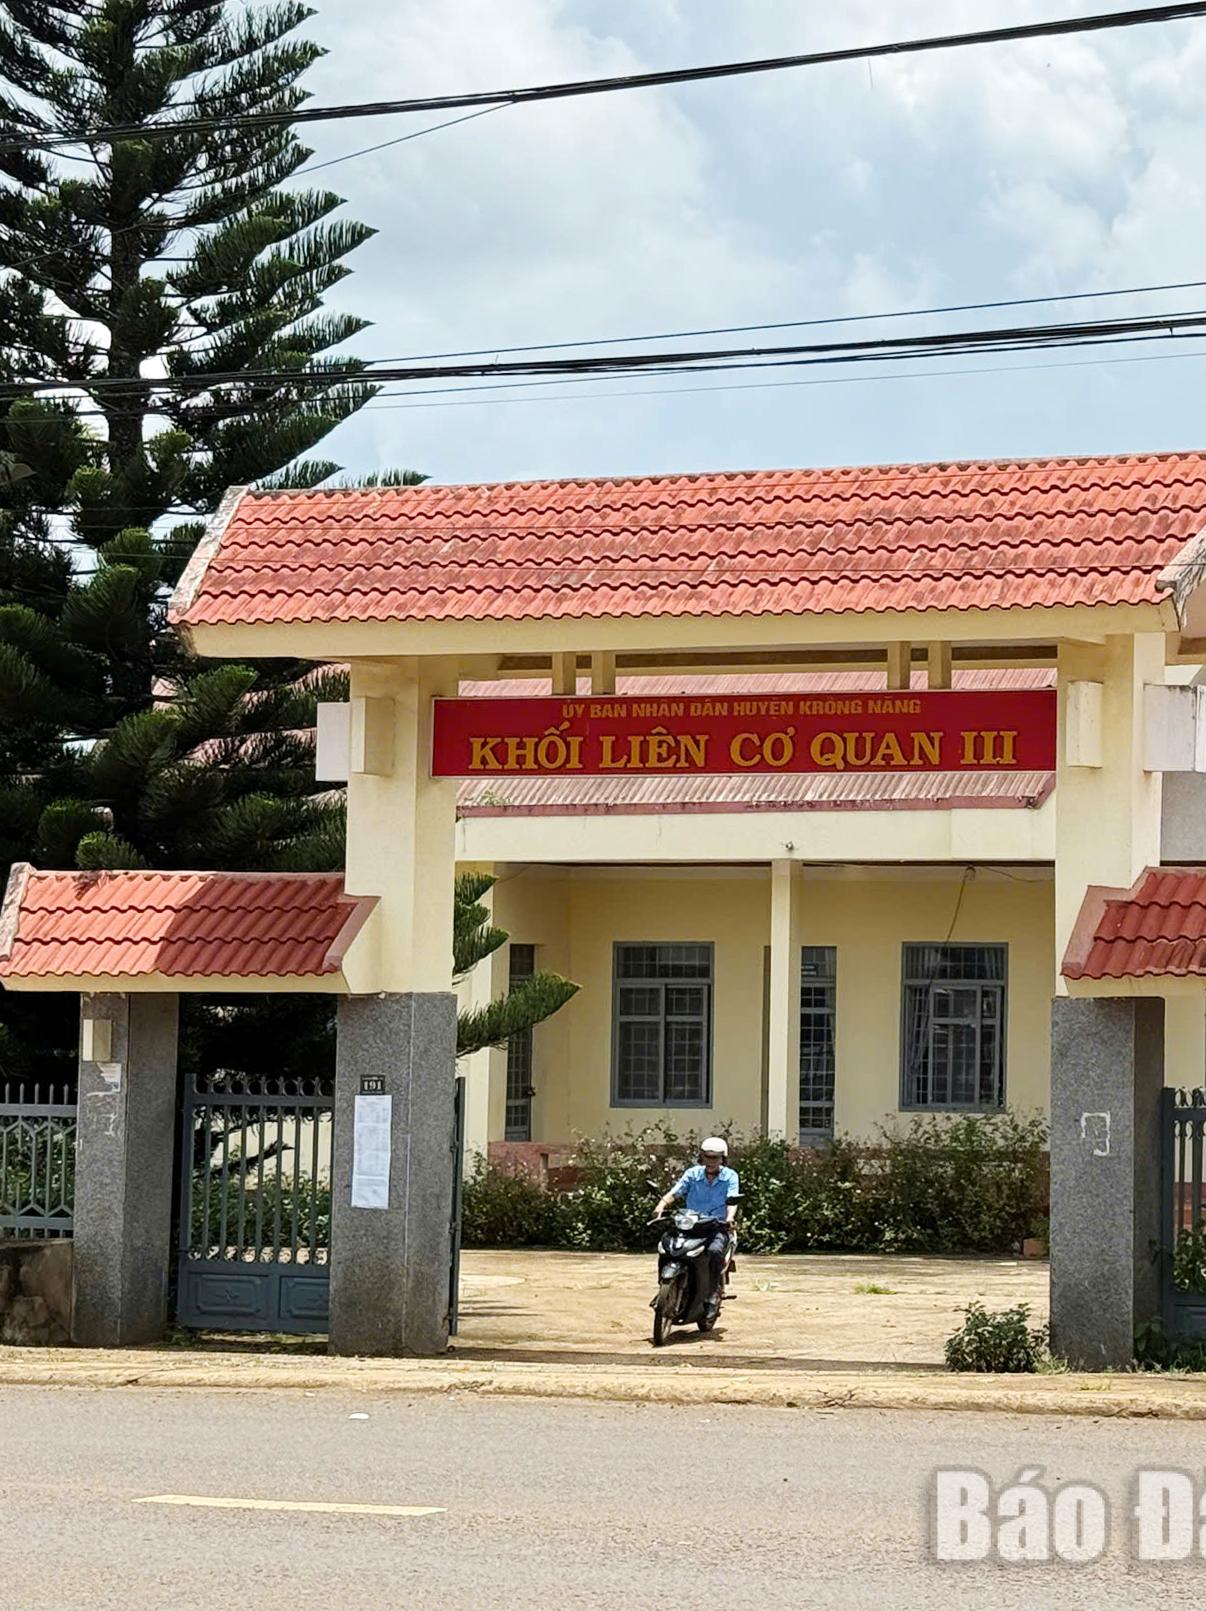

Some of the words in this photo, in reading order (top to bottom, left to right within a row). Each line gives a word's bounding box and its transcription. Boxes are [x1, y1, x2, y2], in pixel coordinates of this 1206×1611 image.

[590, 703, 627, 718] BAN
[632, 699, 684, 717] NHÂN
[690, 699, 728, 716] DÂN
[733, 698, 794, 720] HUYỆN
[800, 697, 862, 715] KRÔNG
[468, 721, 584, 770] KHỐI
[600, 727, 709, 769] LIÊN
[731, 727, 797, 768] CƠ
[811, 732, 944, 771] QUAN
[959, 731, 1017, 765] III
[364, 1081, 382, 1090] 191
